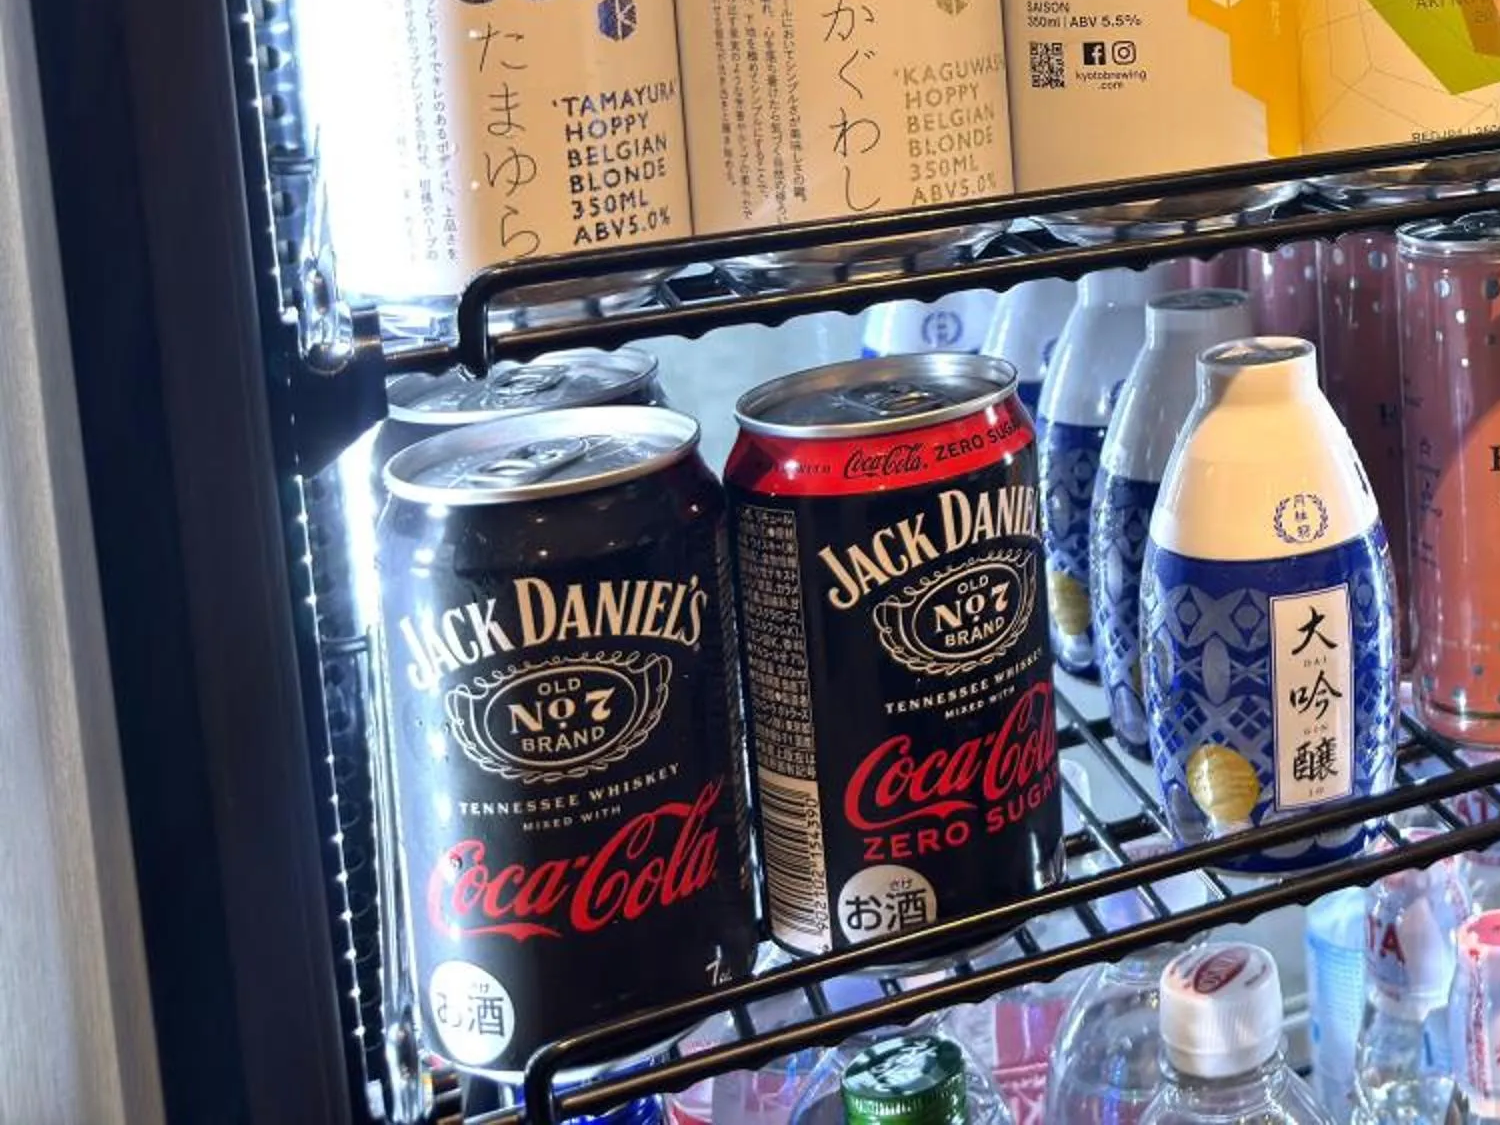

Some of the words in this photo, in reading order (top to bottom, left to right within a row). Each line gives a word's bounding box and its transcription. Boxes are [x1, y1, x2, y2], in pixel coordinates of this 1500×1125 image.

[1027, 0, 1070, 13] SAISON
[1069, 16, 1097, 28] ABV
[1101, 14, 1142, 28] 5.5%
[905, 81, 980, 110] HOPPY
[565, 112, 650, 142] HOPPY
[906, 101, 996, 135] BELGIAN
[475, 22, 542, 257] たまゆら
[567, 136, 668, 168] BELGIAN
[908, 126, 993, 159] BLONDE
[569, 165, 666, 195] BLONDE
[909, 154, 979, 182] 350ML
[571, 189, 650, 220] 350ML
[843, 442, 928, 479] Coca-Cola
[935, 436, 985, 463] ZERO
[818, 512, 940, 610] JACK
[957, 574, 989, 595] OLD
[400, 598, 515, 693] JACK
[513, 575, 708, 648] DANIEL'S
[945, 615, 1005, 648] BRAND
[538, 678, 582, 697] OLD
[884, 673, 989, 715] TENNESSEE
[1290, 606, 1343, 784] 大吟醸
[945, 699, 985, 720] MIXED
[521, 726, 606, 754] BRAND
[459, 794, 580, 817] TENNESSEE
[588, 762, 680, 801] WHISKEY
[582, 805, 622, 823] WITH
[863, 821, 971, 861] ZERO
[427, 778, 724, 943] Coca-Cola
[845, 888, 929, 932] お酒
